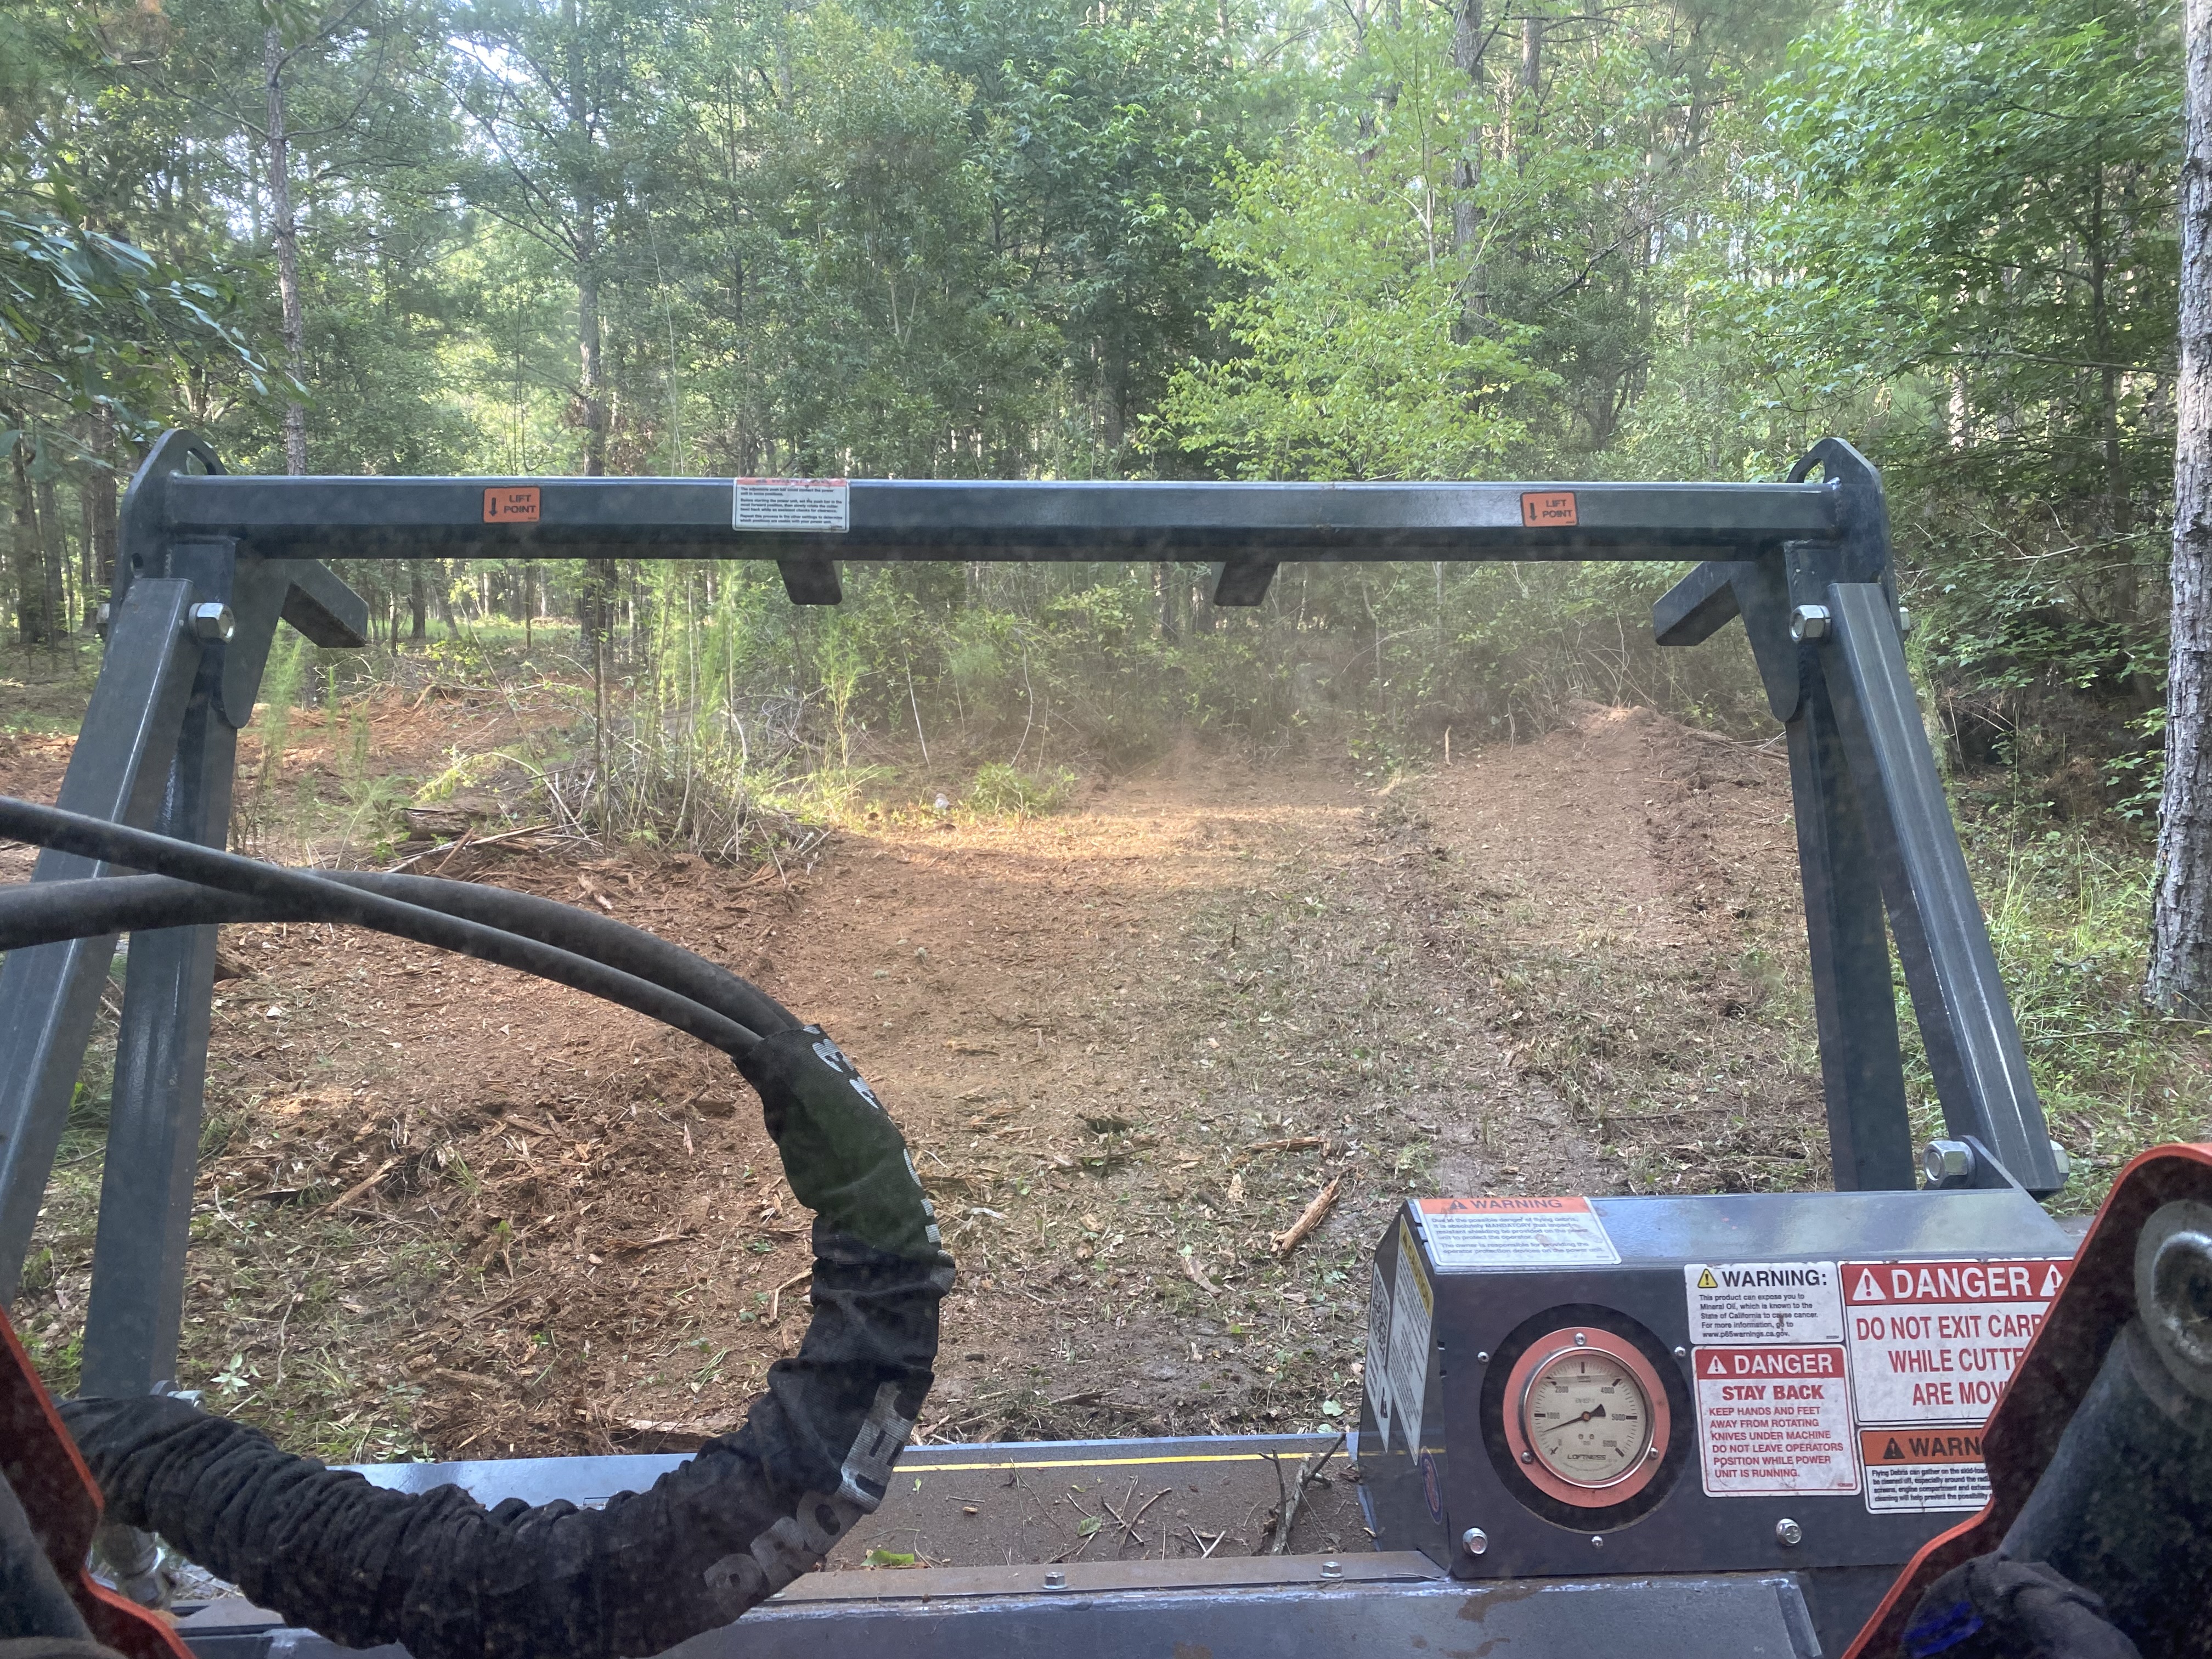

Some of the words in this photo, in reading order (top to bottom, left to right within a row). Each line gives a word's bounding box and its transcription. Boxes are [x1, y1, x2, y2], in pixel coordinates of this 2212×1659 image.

[504, 505, 536, 514] POINT
[1470, 1199, 1563, 1209] WARNING
[1722, 1269, 1827, 1287] WARNING:
[1891, 1267, 2033, 1299] DANGER
[1857, 1318, 1885, 1340] DO
[1891, 1317, 1932, 1340] NOT
[1938, 1316, 1982, 1339] EXIT
[1734, 1353, 1833, 1374] DANGER
[1888, 1349, 1954, 1373] WHILE
[1722, 1386, 1766, 1401] STAY
[1773, 1385, 1825, 1400] BACK
[1912, 1383, 1954, 1406] ARE
[1959, 1381, 2009, 1404] MOV
[1737, 1407, 1771, 1415] HANDS
[1710, 1420, 1737, 1428] AWAY
[1711, 1432, 1746, 1441] KNIVES
[1750, 1432, 1783, 1440] UNDER
[1786, 1431, 1831, 1439] MACHINE
[1730, 1444, 1749, 1453] NOT
[1753, 1444, 1782, 1452] LEAVE
[1785, 1443, 1843, 1452] OPERATORS
[1713, 1457, 1759, 1465] POSITION
[1762, 1457, 1793, 1465] WHILE
[1796, 1455, 1831, 1464] POWER
[1715, 1470, 1737, 1478] UNIT
[1752, 1469, 1800, 1477] RUNNING.
